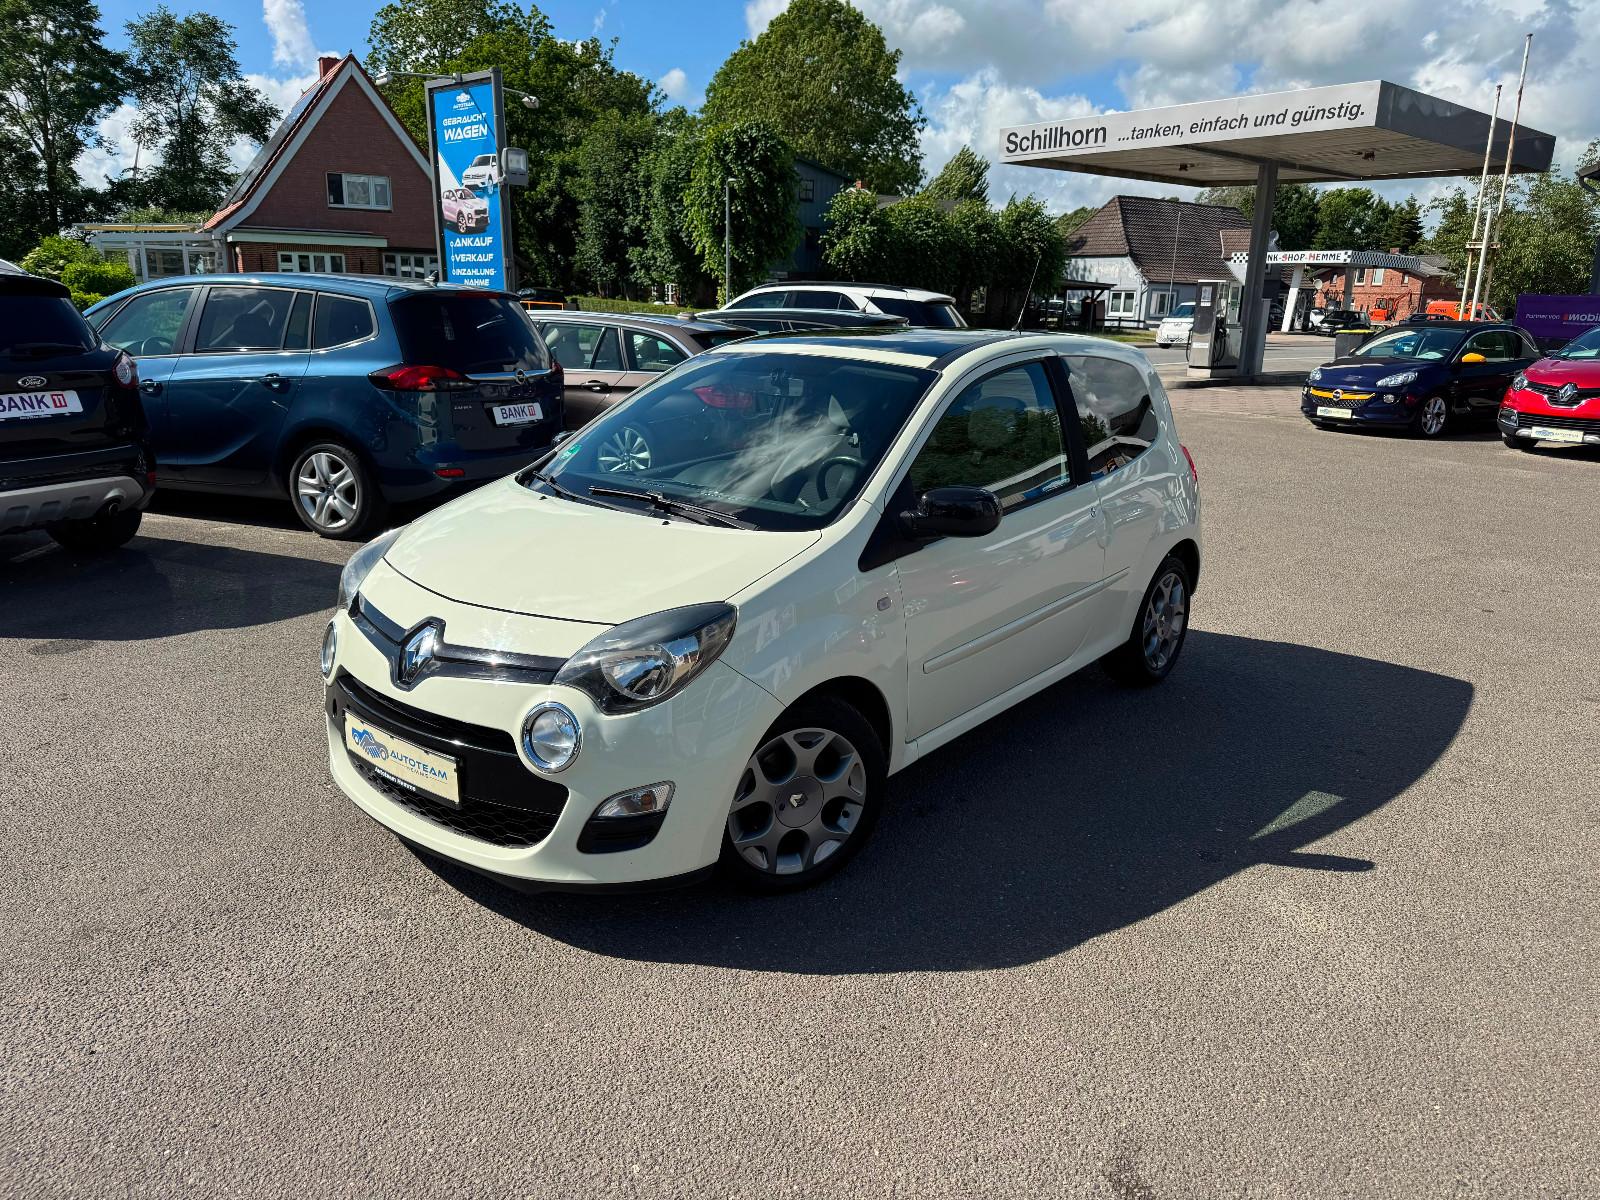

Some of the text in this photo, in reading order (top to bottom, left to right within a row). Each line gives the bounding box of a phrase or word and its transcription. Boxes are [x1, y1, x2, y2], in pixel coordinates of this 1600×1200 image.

[443, 113, 487, 126] GEBRAUCHT
[444, 124, 488, 141] WAGEN
[1006, 126, 1107, 153] Schillhorn
[1190, 113, 1249, 133] einfach
[1254, 108, 1288, 127] und
[1291, 101, 1365, 126] günstig.
[454, 236, 493, 247] ANKAUF
[455, 253, 494, 262] VERKAUF
[1267, 252, 1342, 262] NK-SHOP-HEMME
[464, 278, 490, 286] NAHME
[500, 405, 528, 420] BANK
[390, 750, 448, 780] AUTOTEAM
